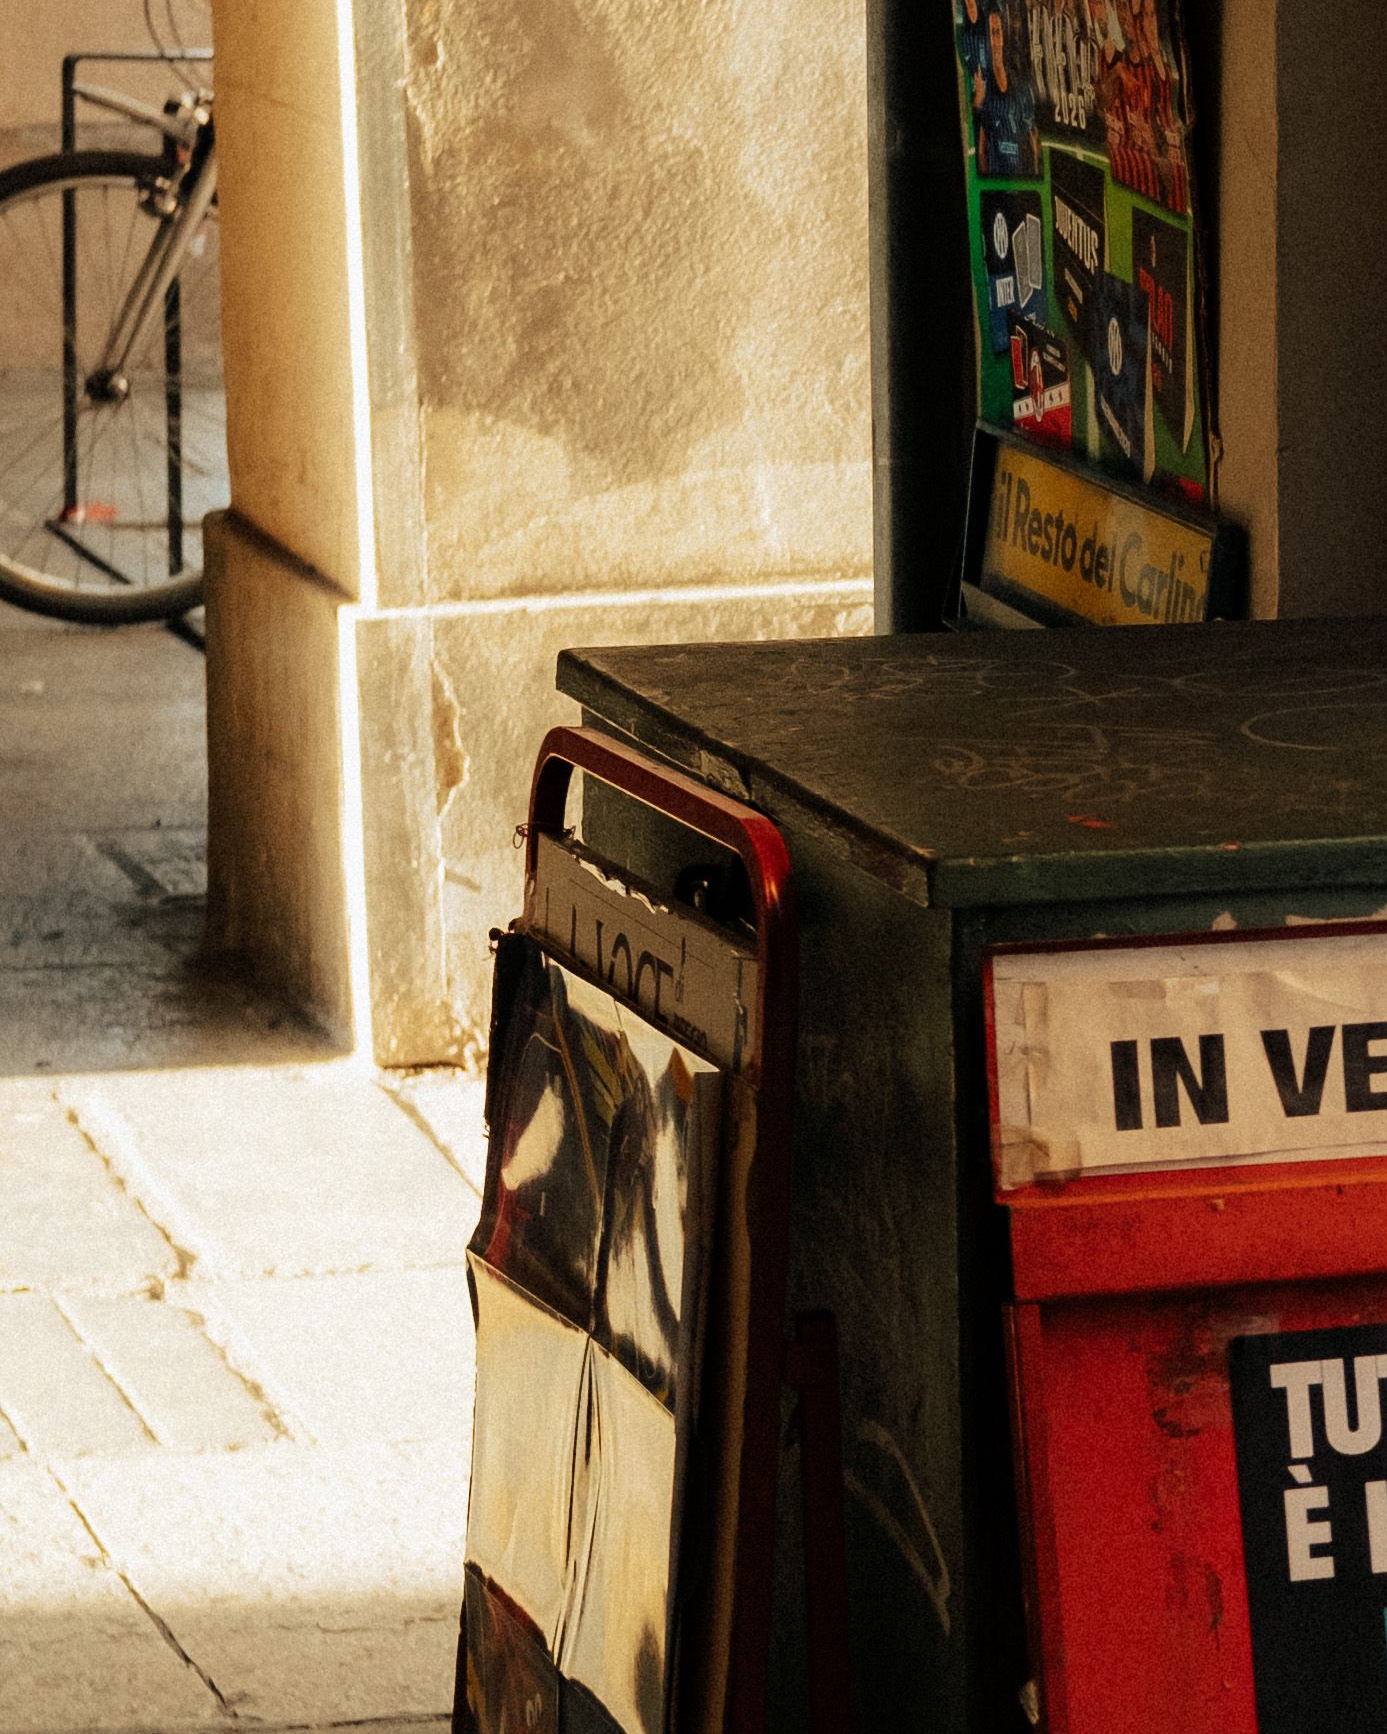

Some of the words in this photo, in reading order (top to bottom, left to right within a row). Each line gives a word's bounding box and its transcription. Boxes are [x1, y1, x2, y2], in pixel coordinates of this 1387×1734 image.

[1013, 478, 1077, 571] Resto
[1081, 522, 1117, 592] del
[1109, 1033, 1228, 1131] IN
[1285, 1464, 1335, 1582] È
